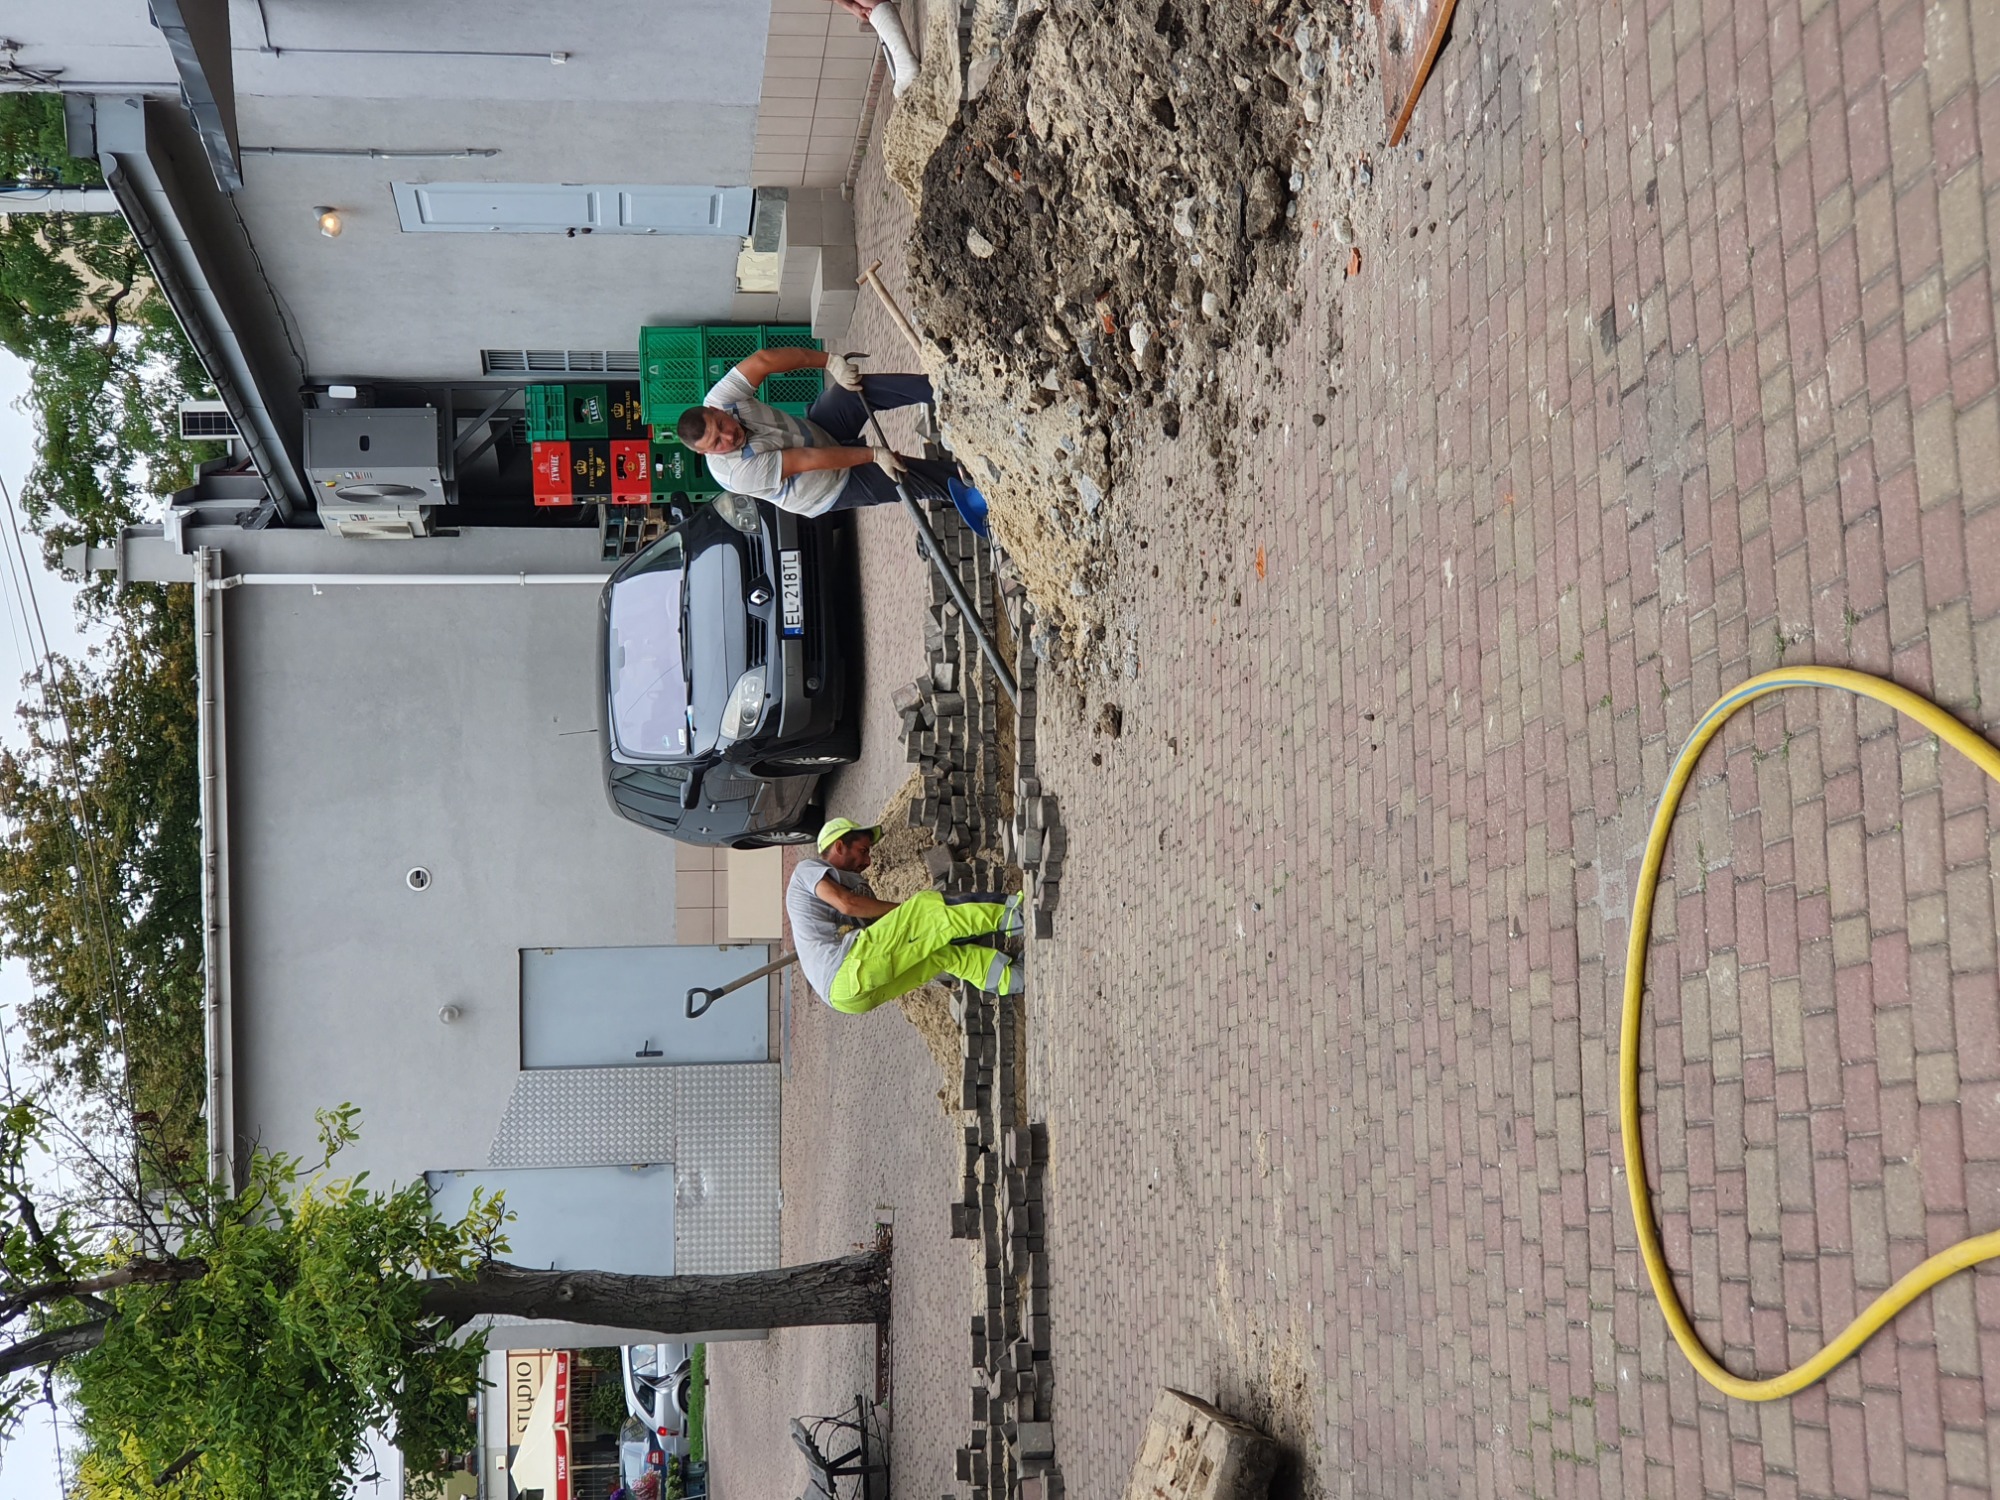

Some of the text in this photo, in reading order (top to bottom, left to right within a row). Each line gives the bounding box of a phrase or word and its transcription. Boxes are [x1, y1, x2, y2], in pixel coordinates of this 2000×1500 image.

[589, 399, 599, 420] LECH
[638, 453, 647, 479] TYSKIE
[783, 554, 799, 625] EL 218TL
[516, 1361, 532, 1433] STUDIO
